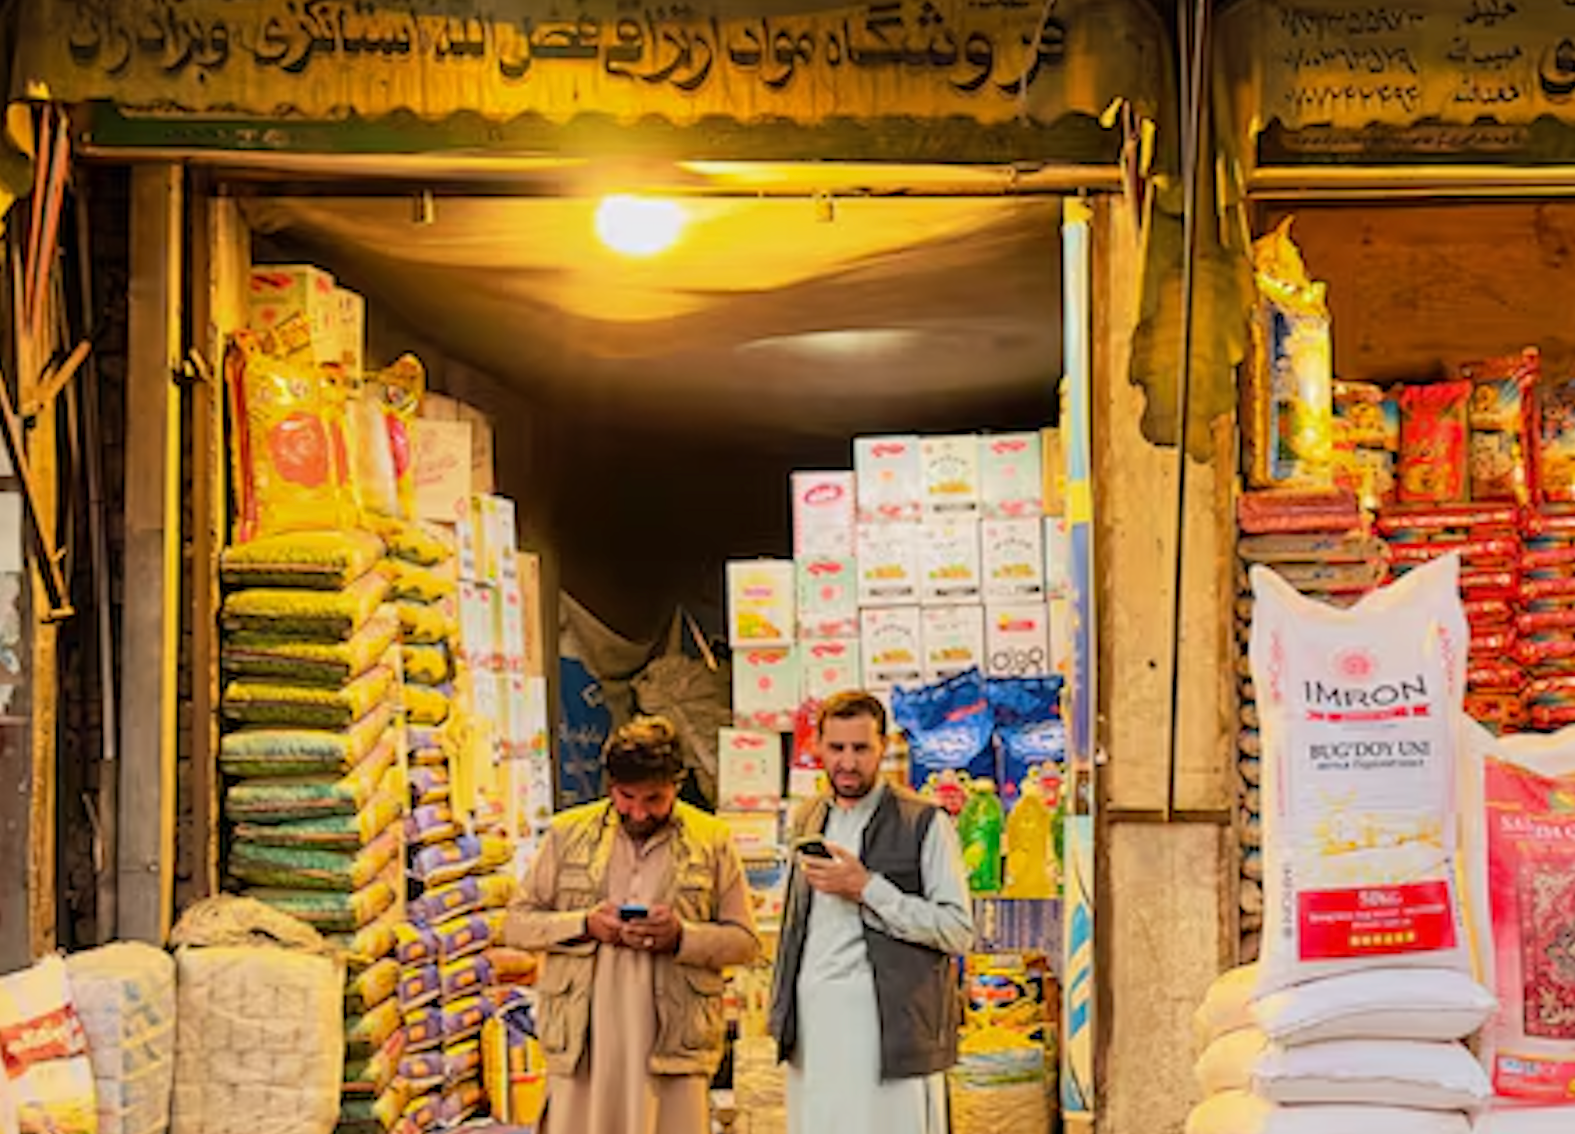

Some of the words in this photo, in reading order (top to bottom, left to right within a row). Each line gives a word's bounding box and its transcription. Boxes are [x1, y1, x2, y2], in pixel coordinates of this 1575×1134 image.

[730, 17, 815, 88] مواد
[824, 3, 1065, 91] فروشگاه
[1304, 674, 1427, 707] IMRON
